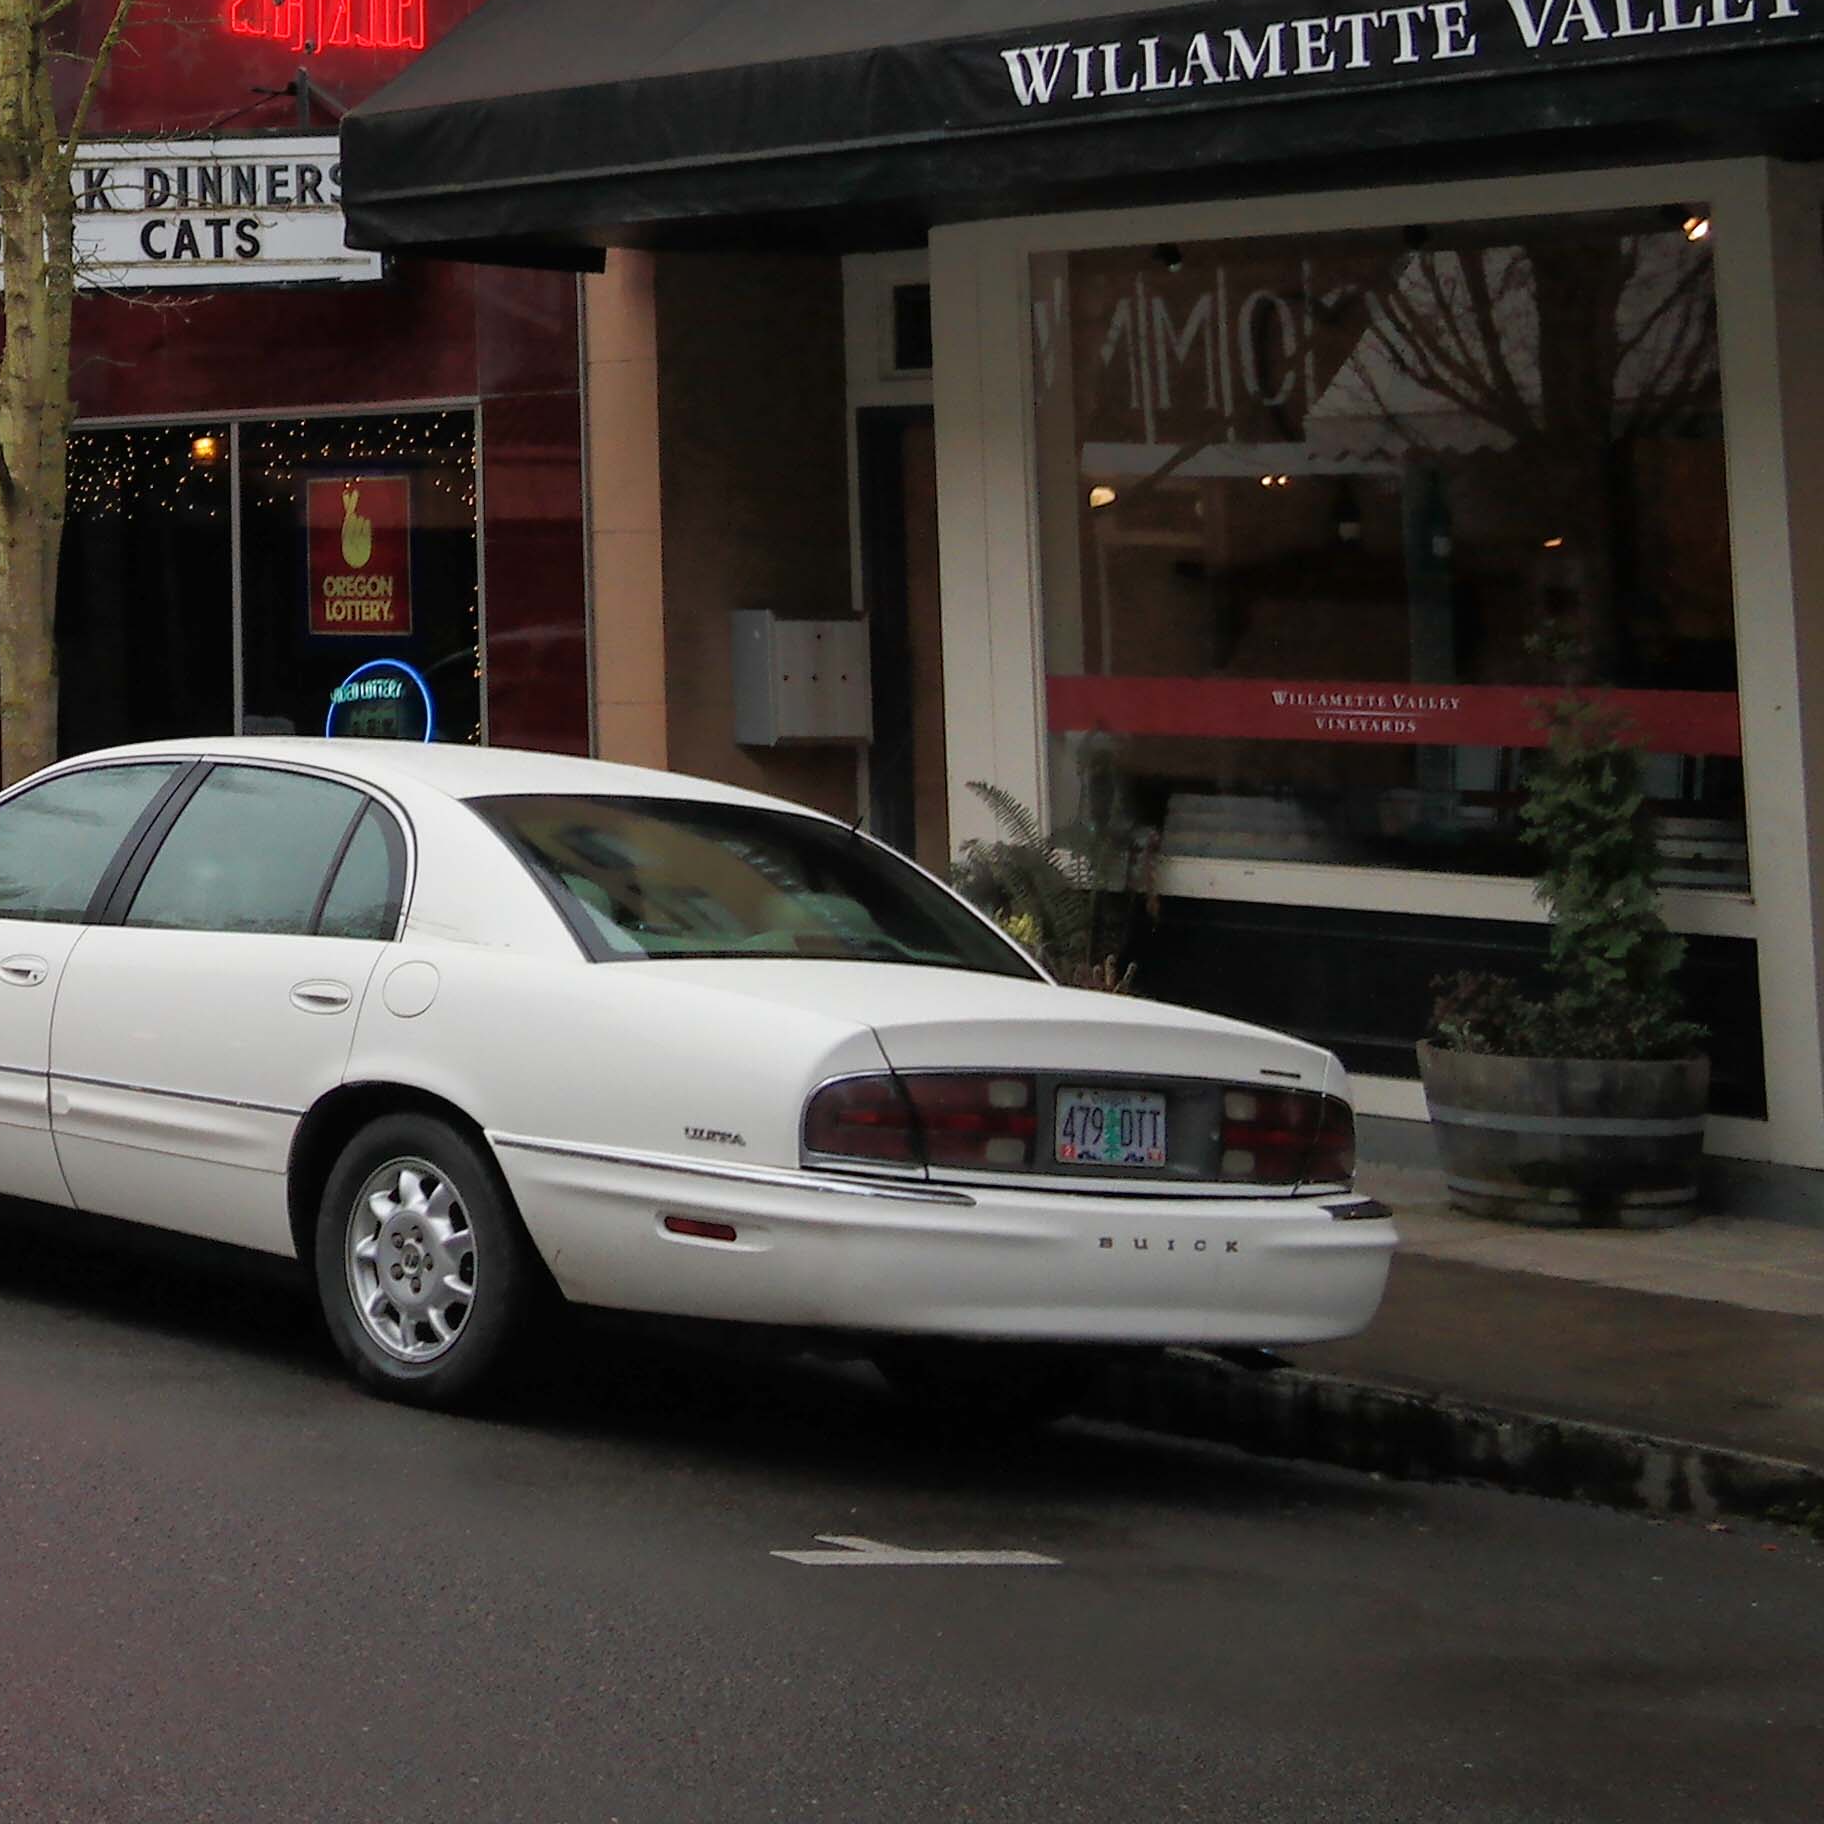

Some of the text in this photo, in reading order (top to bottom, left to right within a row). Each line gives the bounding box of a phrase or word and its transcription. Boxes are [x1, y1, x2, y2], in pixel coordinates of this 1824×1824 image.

[140, 218, 261, 259] CATS
[323, 576, 393, 597] OREGON
[1271, 689, 1461, 711] WILLAMETTE VALLEY
[1315, 717, 1418, 734] VINEYARDS
[1098, 1236, 1239, 1254] BUICK
